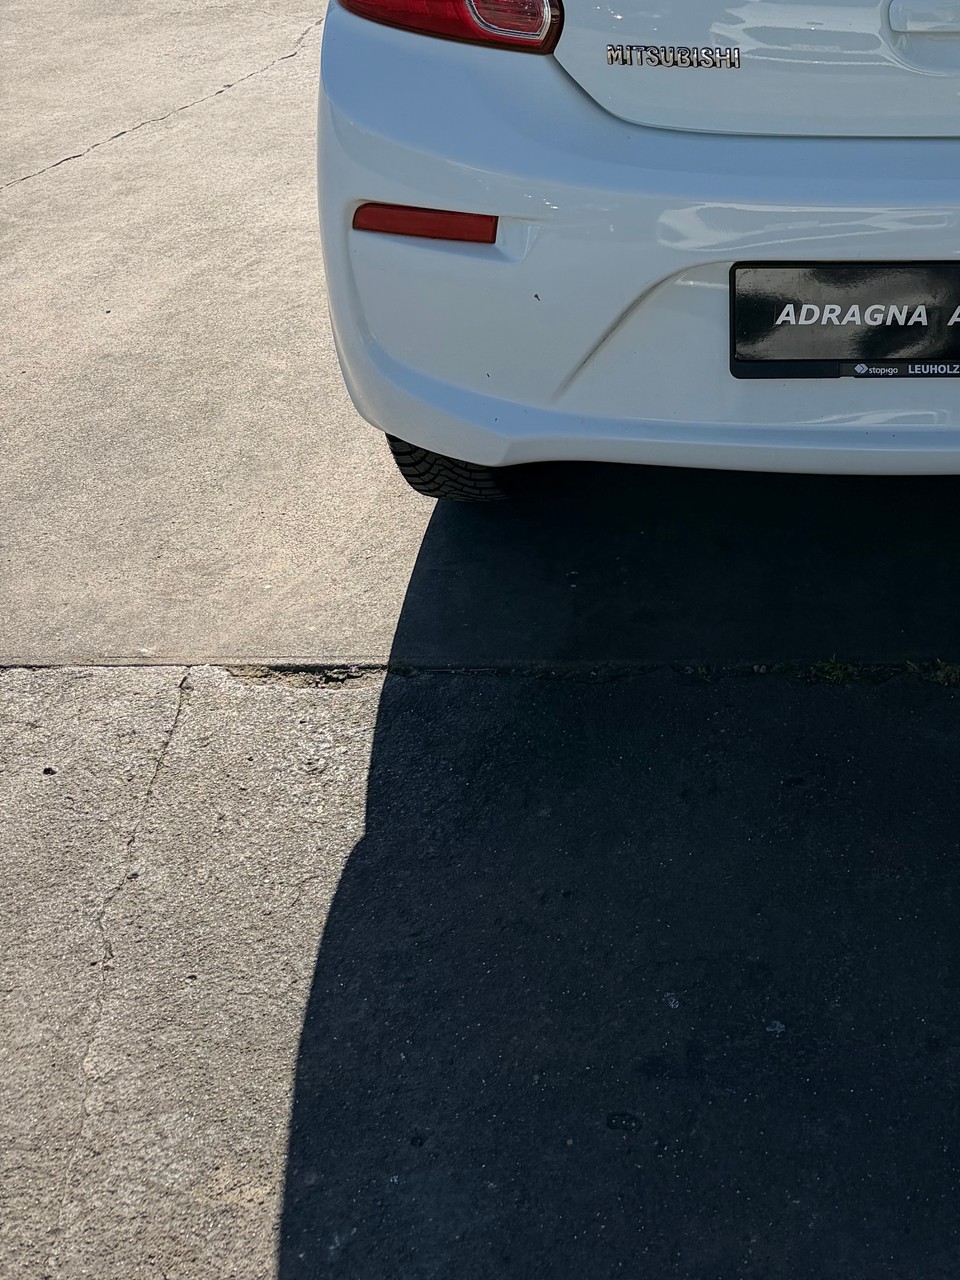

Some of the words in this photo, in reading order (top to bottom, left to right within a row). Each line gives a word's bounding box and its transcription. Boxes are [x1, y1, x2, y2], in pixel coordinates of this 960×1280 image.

[607, 44, 741, 69] MITSUBISHI
[775, 304, 928, 326] ADRAGNA
[908, 364, 960, 375] LEUHOLZ
